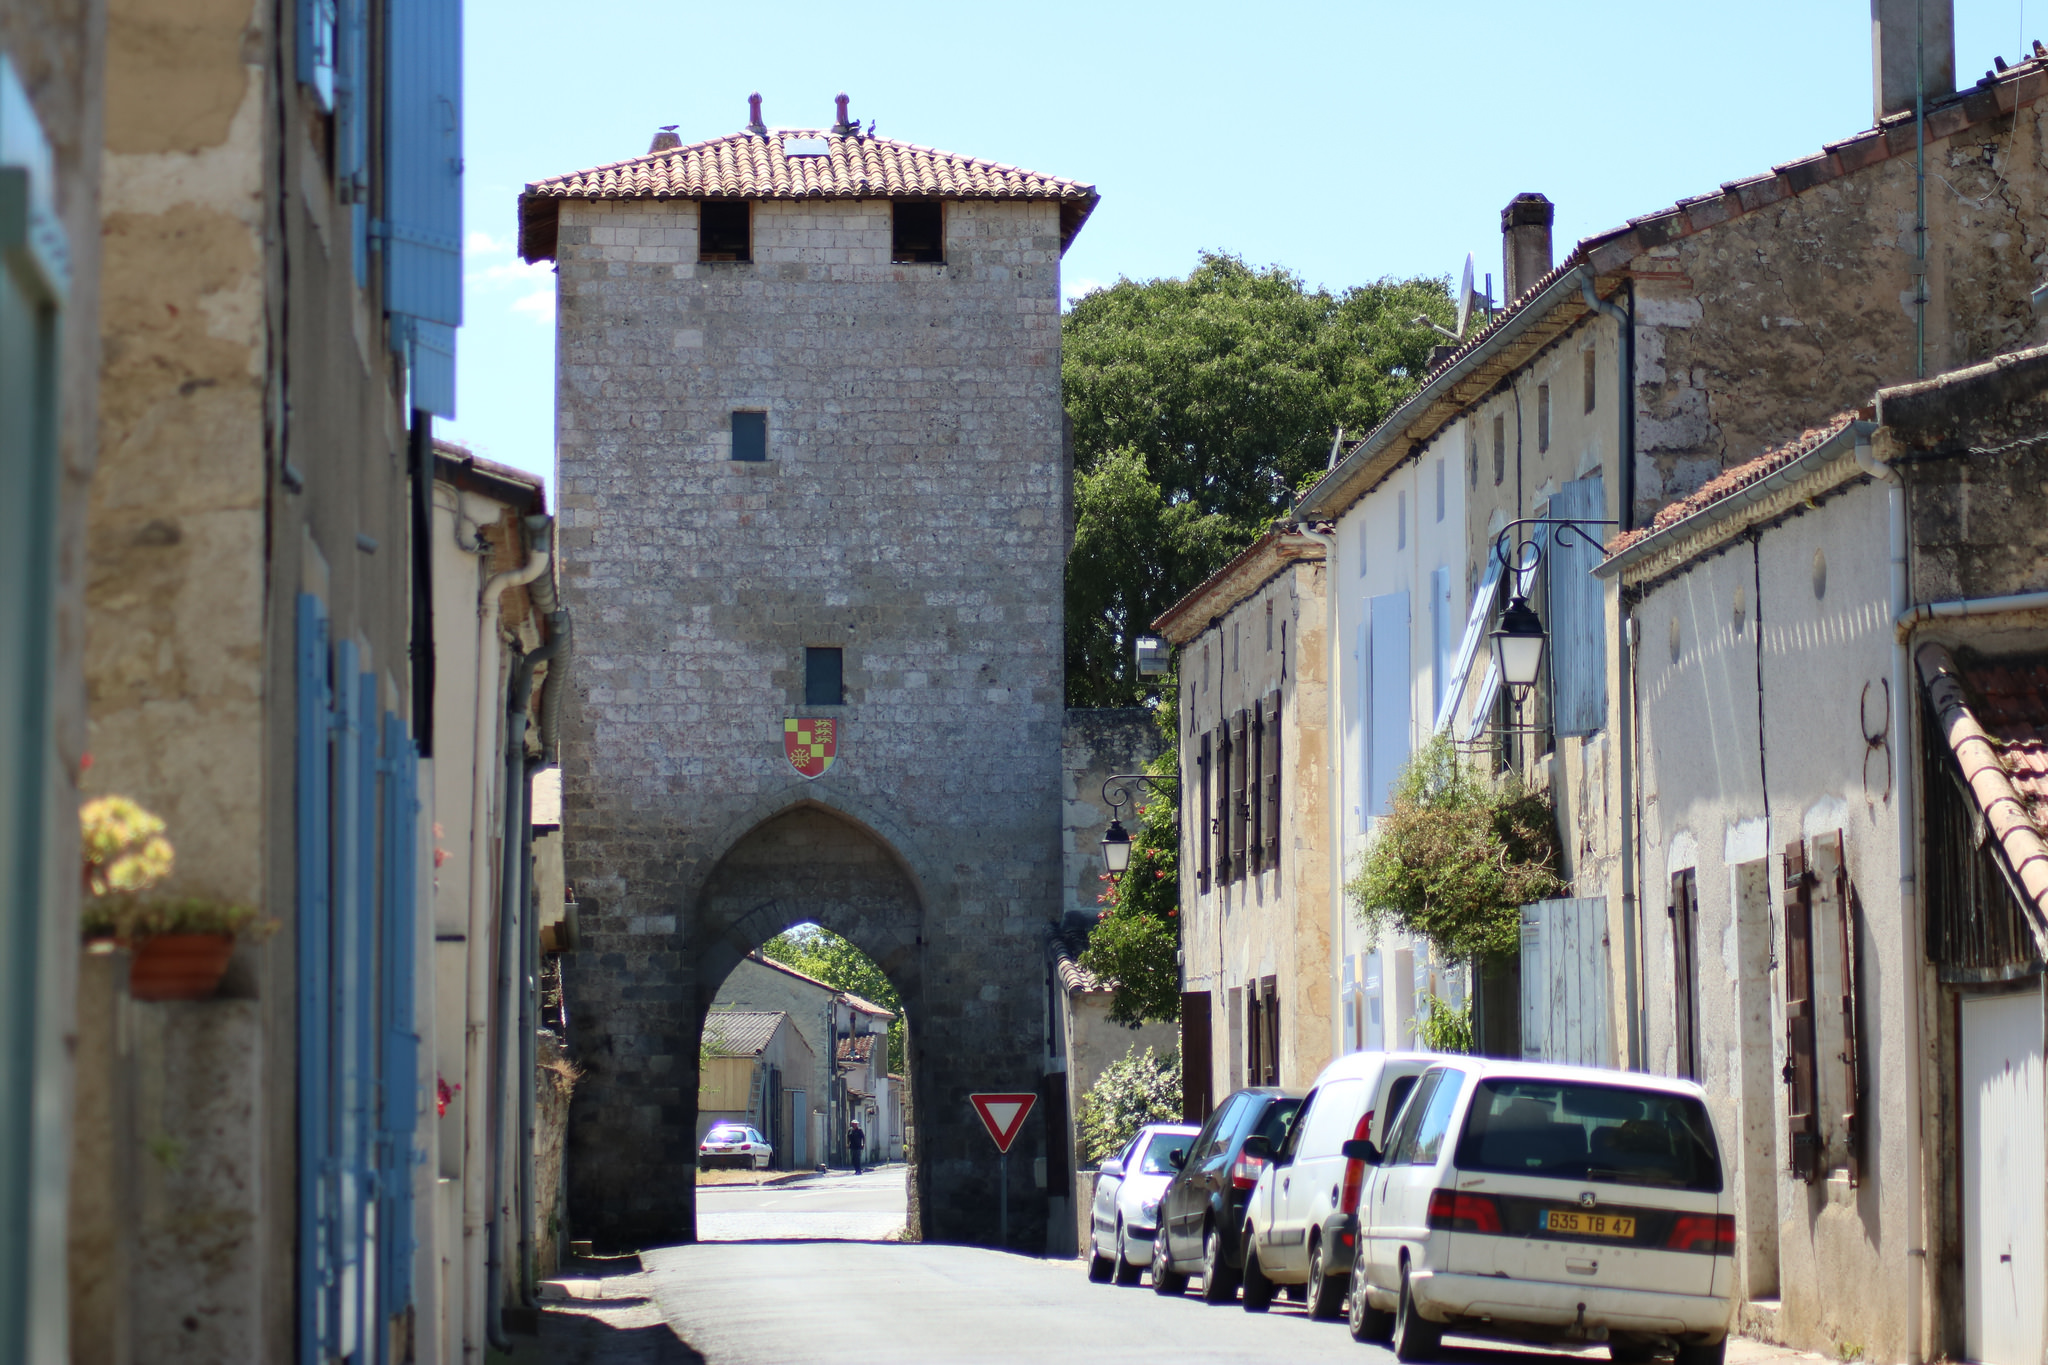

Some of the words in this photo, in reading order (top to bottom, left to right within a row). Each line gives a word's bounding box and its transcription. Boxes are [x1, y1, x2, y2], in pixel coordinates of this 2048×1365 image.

[1550, 1213, 1578, 1230] 635
[1587, 1215, 1605, 1232] TB
[1612, 1218, 1632, 1235] 47
